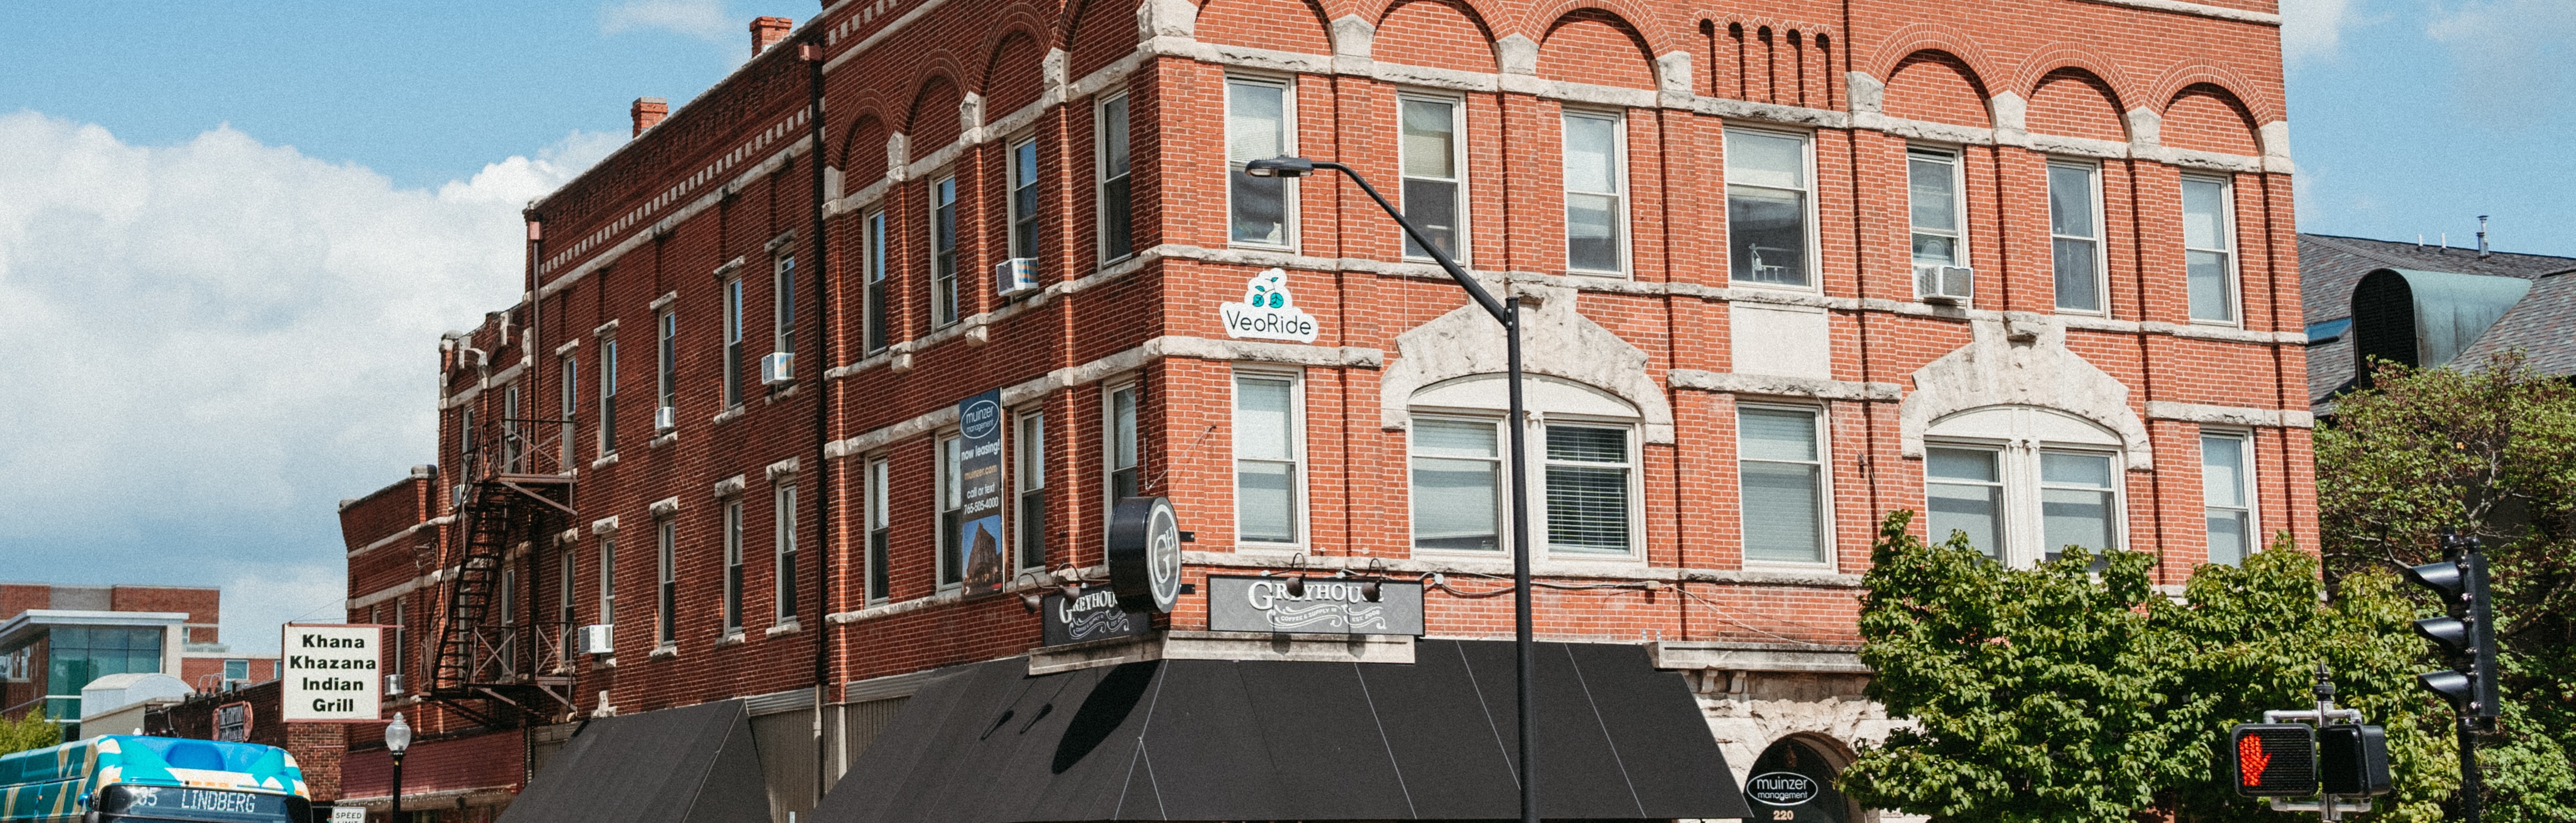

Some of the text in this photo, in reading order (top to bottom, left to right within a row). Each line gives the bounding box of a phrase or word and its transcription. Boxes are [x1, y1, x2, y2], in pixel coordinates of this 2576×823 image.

[1226, 310, 1311, 335] VeoRide
[966, 406, 993, 424] muinzer
[967, 419, 993, 433] management
[961, 438, 1000, 461] now leasing!
[964, 465, 997, 480] muinzer.com
[967, 482, 995, 499] call or text
[964, 496, 999, 515] 765-505-4000
[1248, 581, 1384, 610] GRYHOU
[1059, 590, 1118, 624] GREYHOU
[1308, 608, 1329, 617] SUPPLY
[303, 634, 365, 648] Khana
[290, 655, 376, 669] Khazana
[303, 677, 364, 691] Indian
[313, 698, 353, 712] Grill
[1757, 776, 1808, 790] muinzer
[181, 789, 256, 813] LINDBERG
[1758, 791, 1808, 801] management
[1773, 810, 1794, 820] 220
